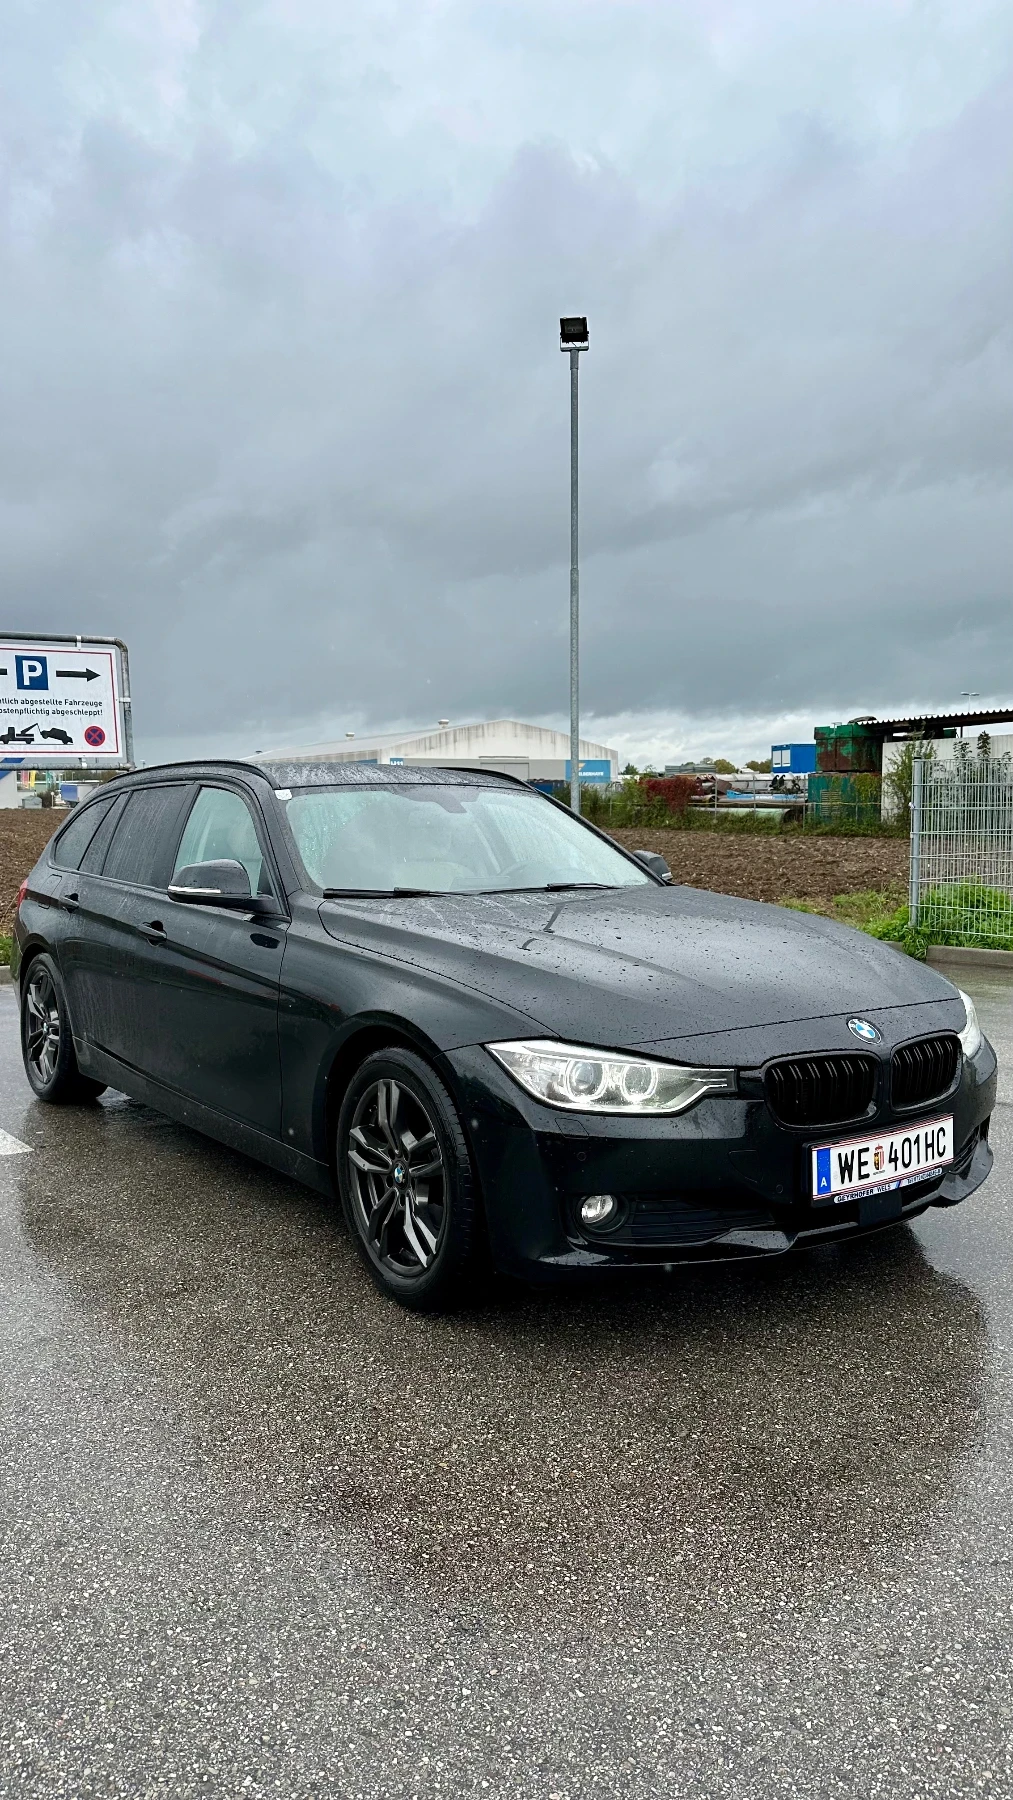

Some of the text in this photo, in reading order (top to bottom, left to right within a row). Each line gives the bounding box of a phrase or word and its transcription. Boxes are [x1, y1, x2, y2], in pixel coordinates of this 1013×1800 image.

[22, 660, 42, 685] P
[20, 698, 62, 706] abgestellte
[64, 699, 103, 707] Fahrzeuge
[51, 708, 103, 716] abgeschleppt!
[837, 1127, 946, 1184] WE 401HC
[820, 1177, 827, 1187] A
